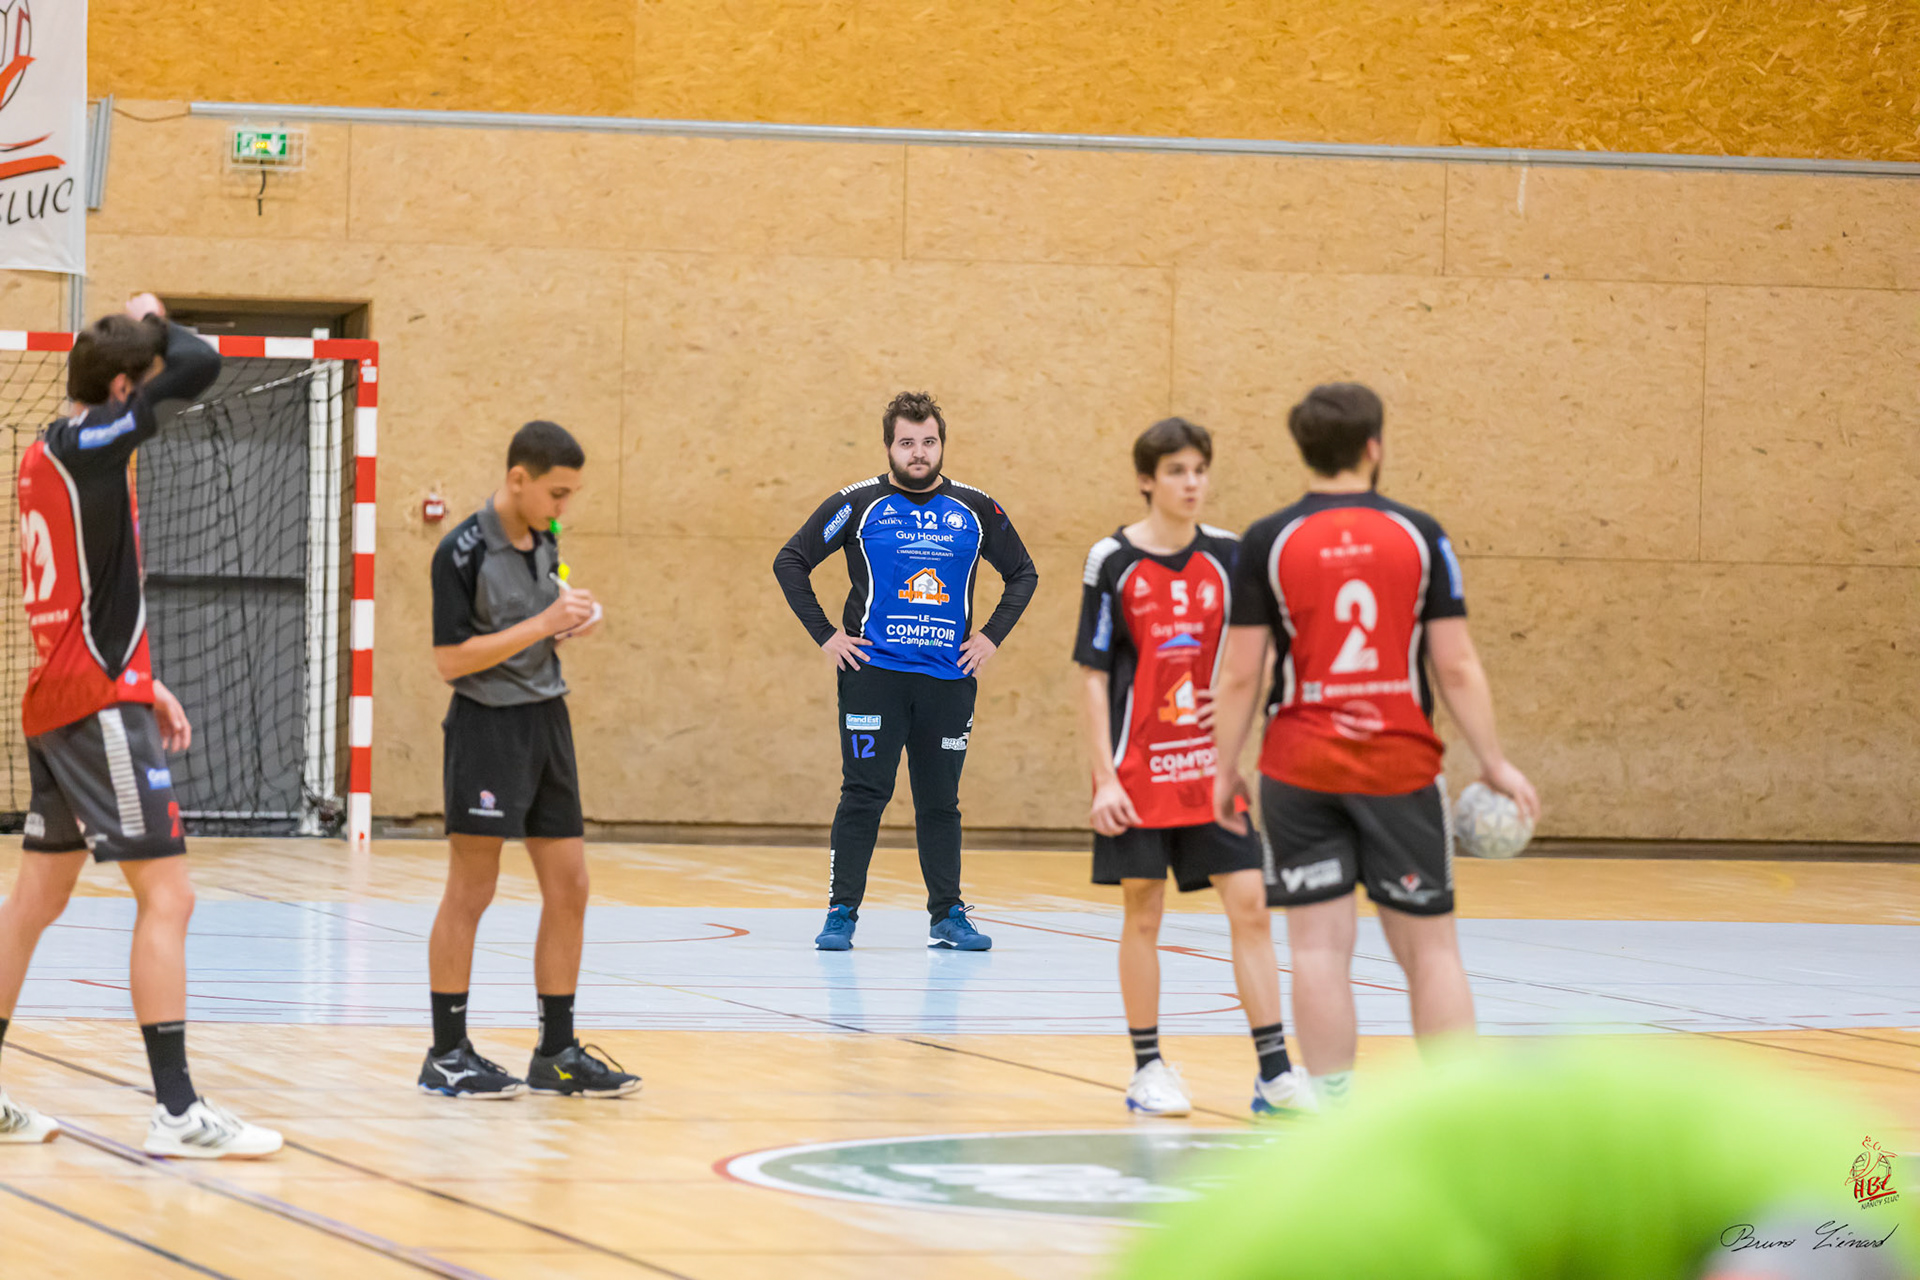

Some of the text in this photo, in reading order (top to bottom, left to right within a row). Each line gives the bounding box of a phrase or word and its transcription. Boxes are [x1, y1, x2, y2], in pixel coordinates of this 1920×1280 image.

[0, 177, 74, 225] LUC
[909, 510, 939, 530] 12
[895, 530, 955, 543] Guy Hoquet
[1170, 579, 1190, 616] 5
[918, 614, 930, 623] LE
[1329, 578, 1379, 674] 2
[886, 624, 956, 641] COMPTOIR
[900, 636, 944, 648] Campanile
[851, 733, 876, 759] 12
